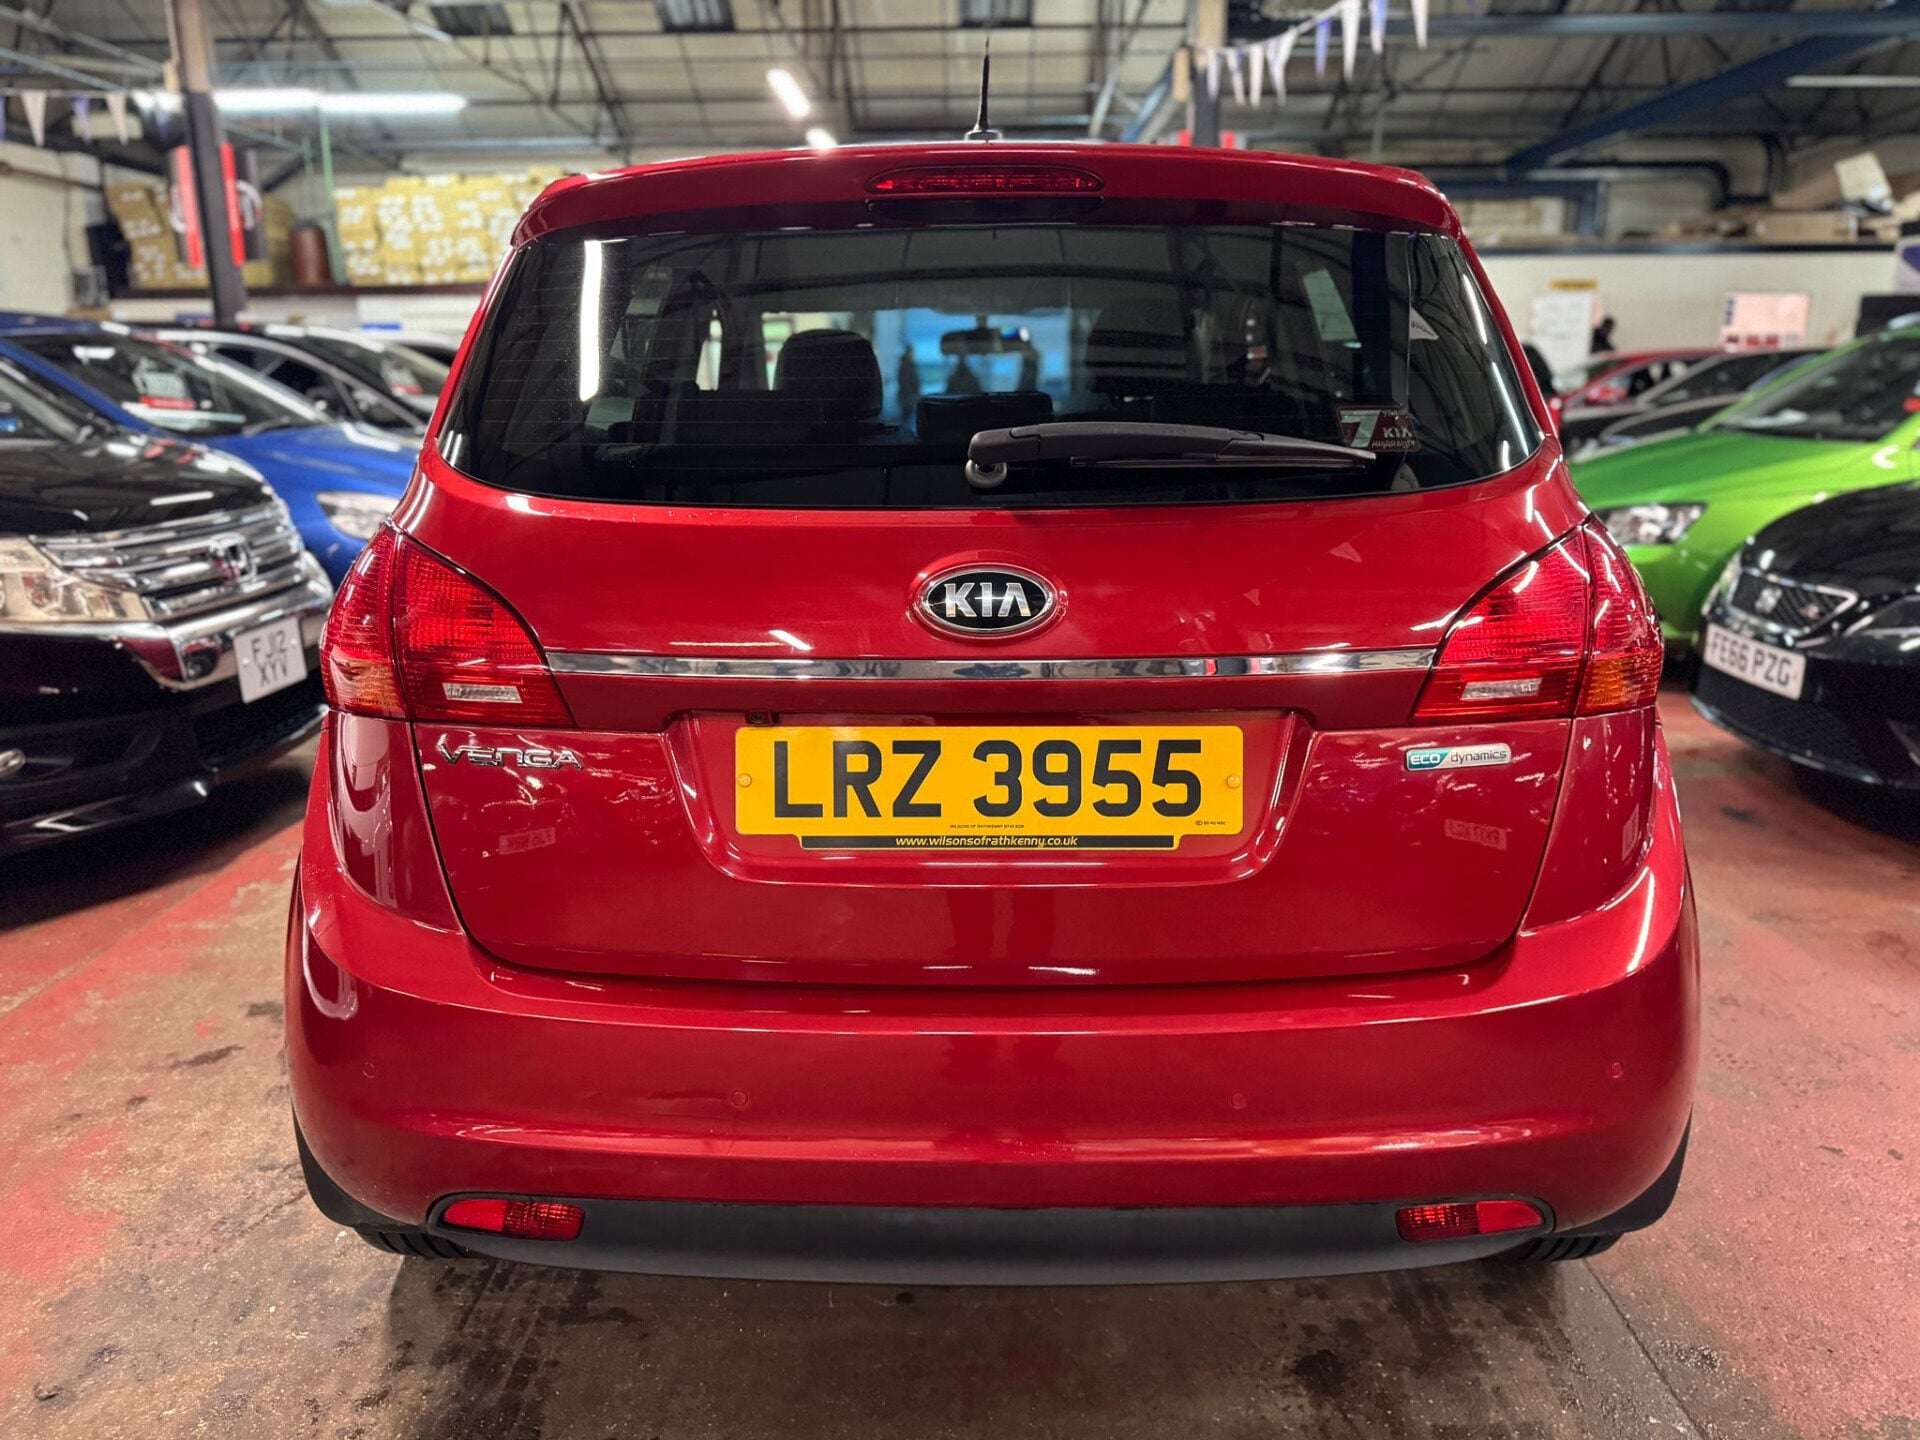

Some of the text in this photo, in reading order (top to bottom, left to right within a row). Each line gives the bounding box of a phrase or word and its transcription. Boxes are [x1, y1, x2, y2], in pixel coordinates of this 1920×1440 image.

[1340, 409, 1380, 447] 7
[944, 582, 1032, 618] KIA
[1711, 631, 1792, 687] FE66 PZG
[436, 733, 583, 769] VENGA
[1410, 750, 1507, 765] ECO dynamics
[773, 739, 1202, 819] LRZ 3955
[895, 835, 1079, 849] www.wilsonsofrathkenny.co.uk
